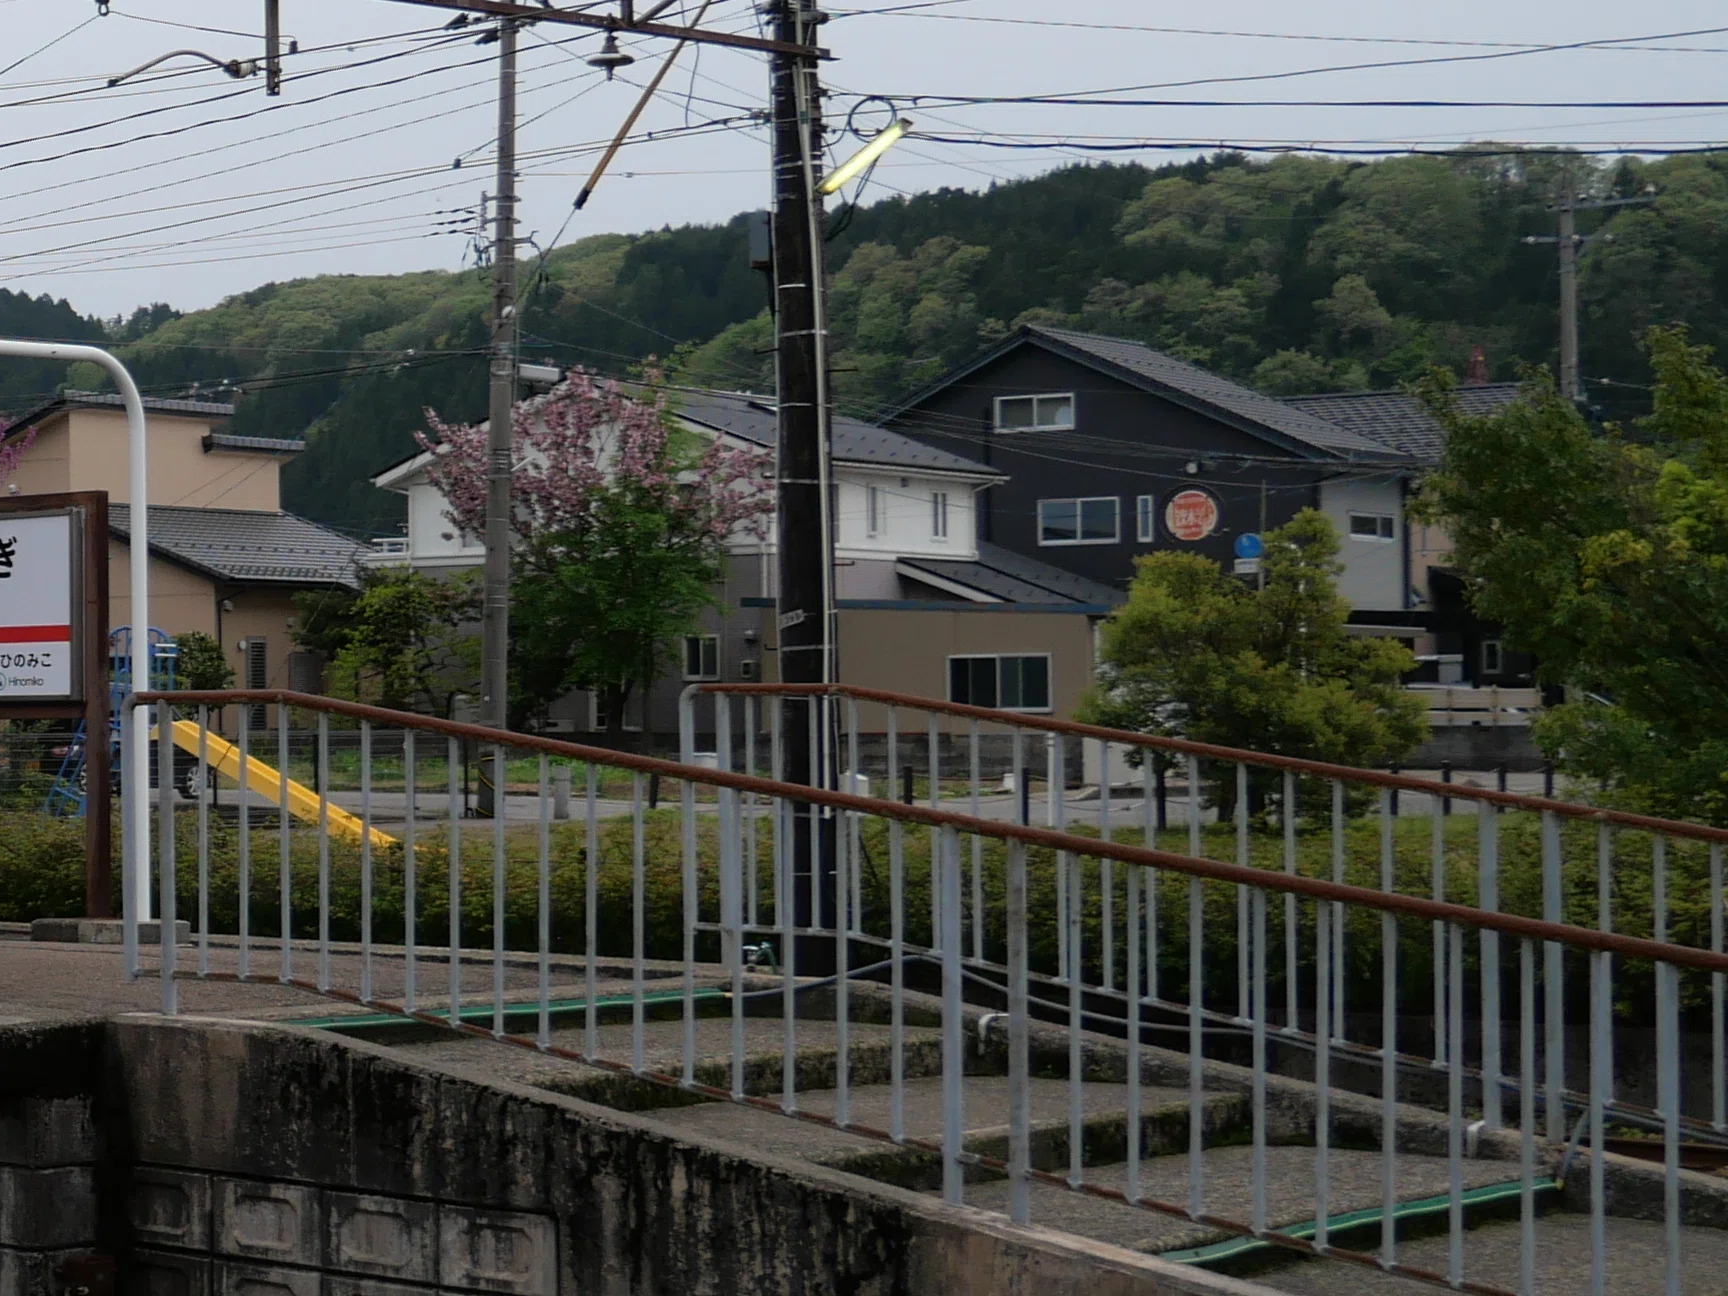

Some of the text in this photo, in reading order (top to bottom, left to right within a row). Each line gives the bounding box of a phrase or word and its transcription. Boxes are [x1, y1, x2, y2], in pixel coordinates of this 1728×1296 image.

[0, 653, 52, 668] ひのみこ
[8, 676, 44, 687] Hinomiko
